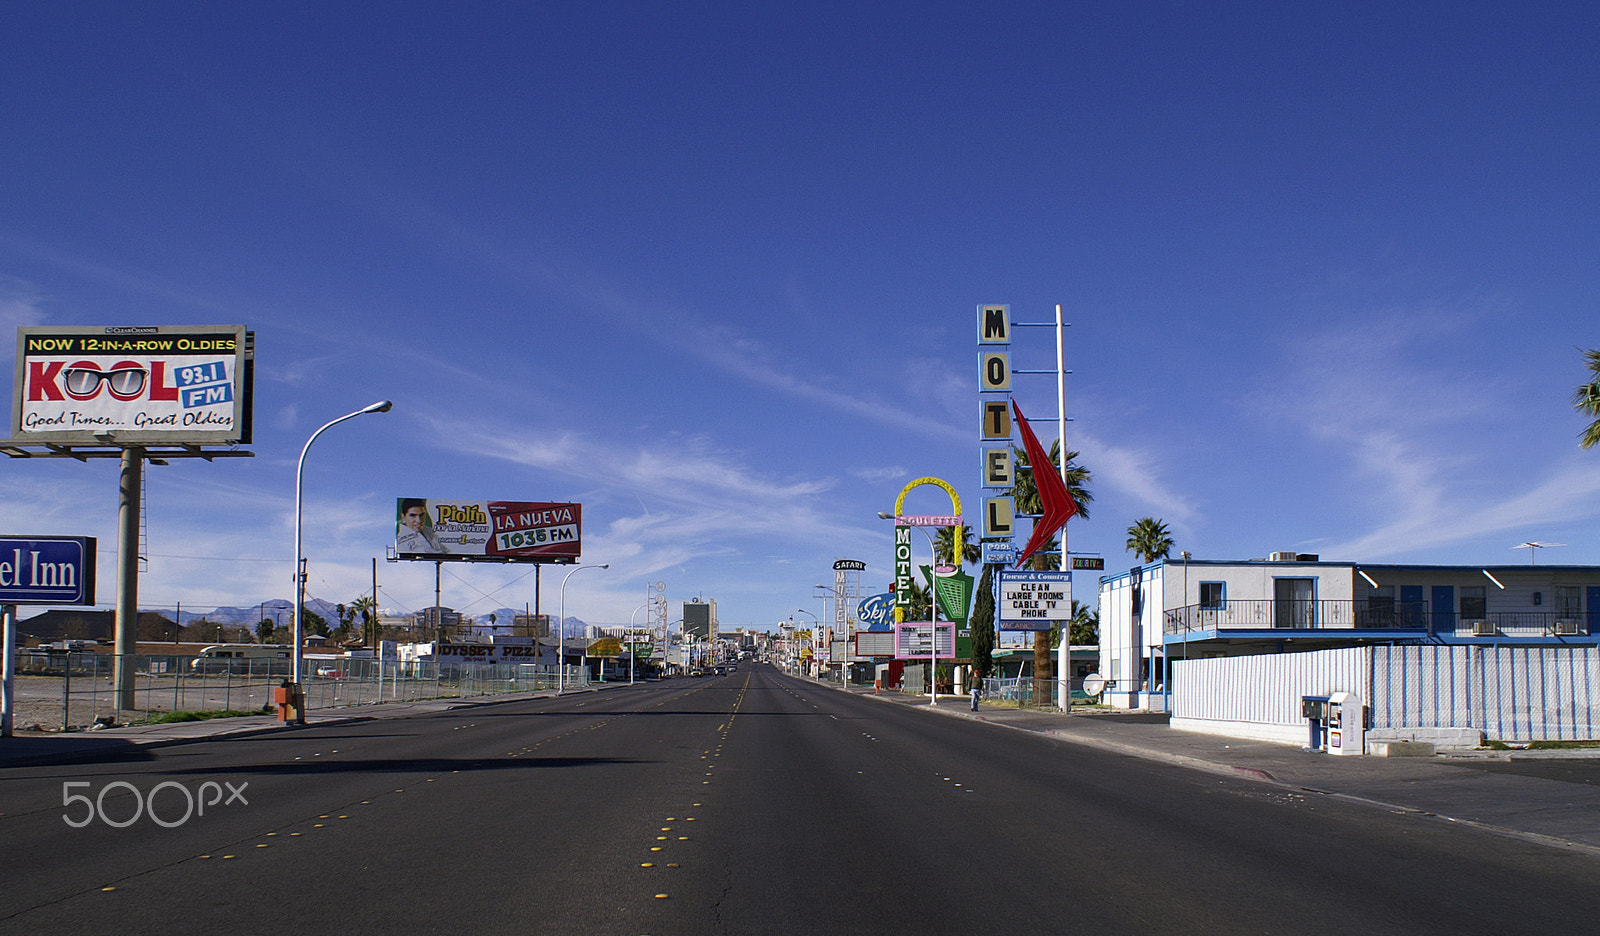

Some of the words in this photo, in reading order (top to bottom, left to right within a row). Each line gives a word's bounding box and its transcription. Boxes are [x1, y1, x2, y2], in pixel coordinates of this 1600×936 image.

[29, 339, 74, 351] NOW
[80, 339, 173, 351] 12-IN-A-ROW
[27, 360, 179, 402] KOOL
[181, 364, 217, 385] 93.1
[189, 386, 226, 406] FM
[25, 411, 65, 428] Good
[69, 411, 125, 426] Times...
[134, 411, 178, 428] Great
[183, 411, 233, 427] Oldies
[984, 309, 1010, 532] MOTEL
[436, 504, 487, 524] Piolín
[496, 515, 516, 530] LA
[520, 508, 573, 527] NUEVA
[900, 516, 958, 525] ROULETTE
[550, 527, 574, 541] FM
[29, 551, 76, 587] Inn
[835, 561, 863, 569] SAFARI
[896, 528, 910, 605] MOTEL
[1037, 573, 1069, 581] Country
[1006, 592, 1032, 600] LARGE
[1037, 592, 1064, 600] ROOMS
[1021, 583, 1050, 591] CLEAN
[861, 596, 886, 624] Sky
[1046, 601, 1056, 609] TV
